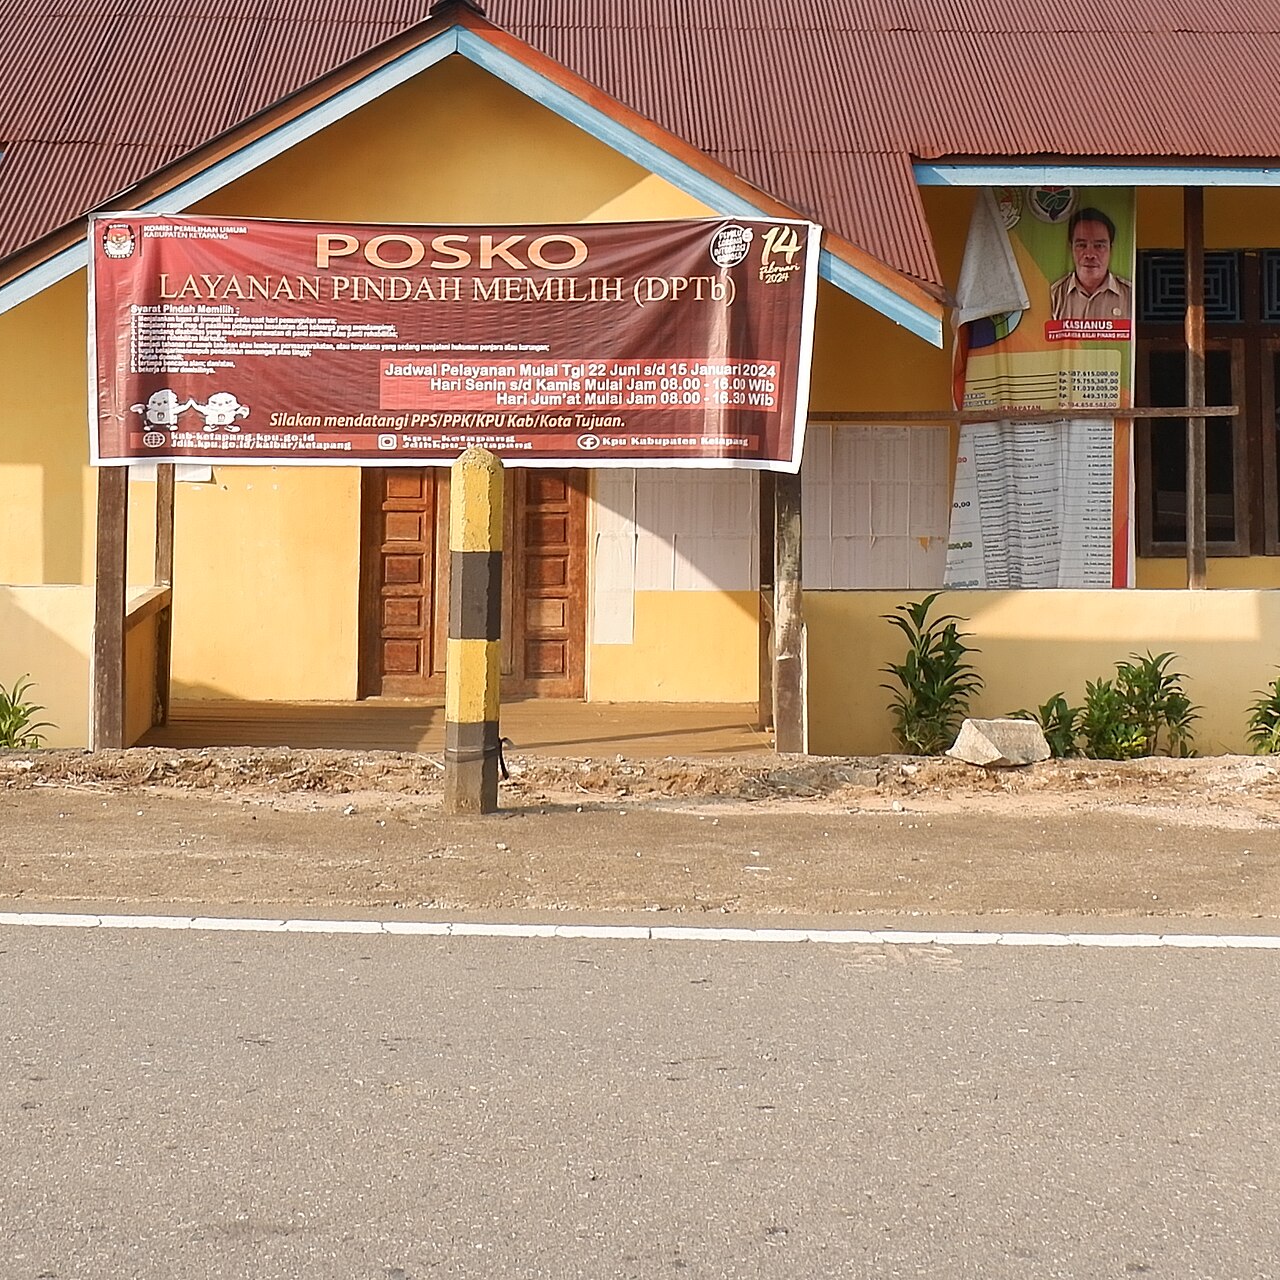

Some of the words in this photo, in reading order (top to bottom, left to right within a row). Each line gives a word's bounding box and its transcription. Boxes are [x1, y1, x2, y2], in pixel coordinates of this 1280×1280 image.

[143, 231, 187, 239] KABUPATEN
[189, 232, 228, 240] KETAPANG
[174, 225, 219, 233] PEMILIHAN
[220, 226, 247, 234] UMUM
[761, 225, 802, 265] 14
[316, 234, 590, 270] POSKO
[765, 273, 789, 284] 2024
[158, 275, 322, 301] LAYANAN
[331, 276, 460, 302] PINDAH
[472, 276, 623, 302] MEMILIH
[632, 274, 736, 307] (DPTb)
[131, 305, 161, 314] Syarat
[163, 305, 196, 313] Pindah
[198, 305, 234, 314] Memilih
[1063, 321, 1113, 329] KASIANUS
[384, 364, 437, 377] Jadwal
[441, 364, 516, 380] Pelayanan
[520, 364, 558, 377] Mulai
[561, 364, 584, 380] Tgl
[588, 364, 606, 377] 22
[609, 364, 641, 377] Juni
[643, 364, 666, 377] s/d
[670, 364, 688, 377] 15
[691, 364, 742, 377] Januari
[743, 365, 776, 379] 2024
[430, 378, 461, 391] Hari
[465, 379, 506, 392] Senin
[510, 378, 532, 392] s/d
[536, 378, 580, 391] Kamis
[585, 378, 623, 391] Mulai
[626, 379, 656, 391] Jam
[660, 378, 701, 391] 08.00
[748, 379, 775, 393] Wib
[496, 393, 527, 405] Hari
[585, 393, 623, 405] Mulai
[626, 393, 656, 405] Jam
[660, 393, 701, 405] 08.00
[748, 393, 774, 406] Wib
[269, 413, 320, 428] Silakan
[324, 414, 408, 430] mendatangi
[411, 414, 504, 429] PPS/PPK/KPU
[507, 414, 571, 429] Kab/Kota
[575, 414, 625, 431] Tujuan.
[602, 437, 626, 446] Kpu
[631, 437, 697, 446] Kabupaten
